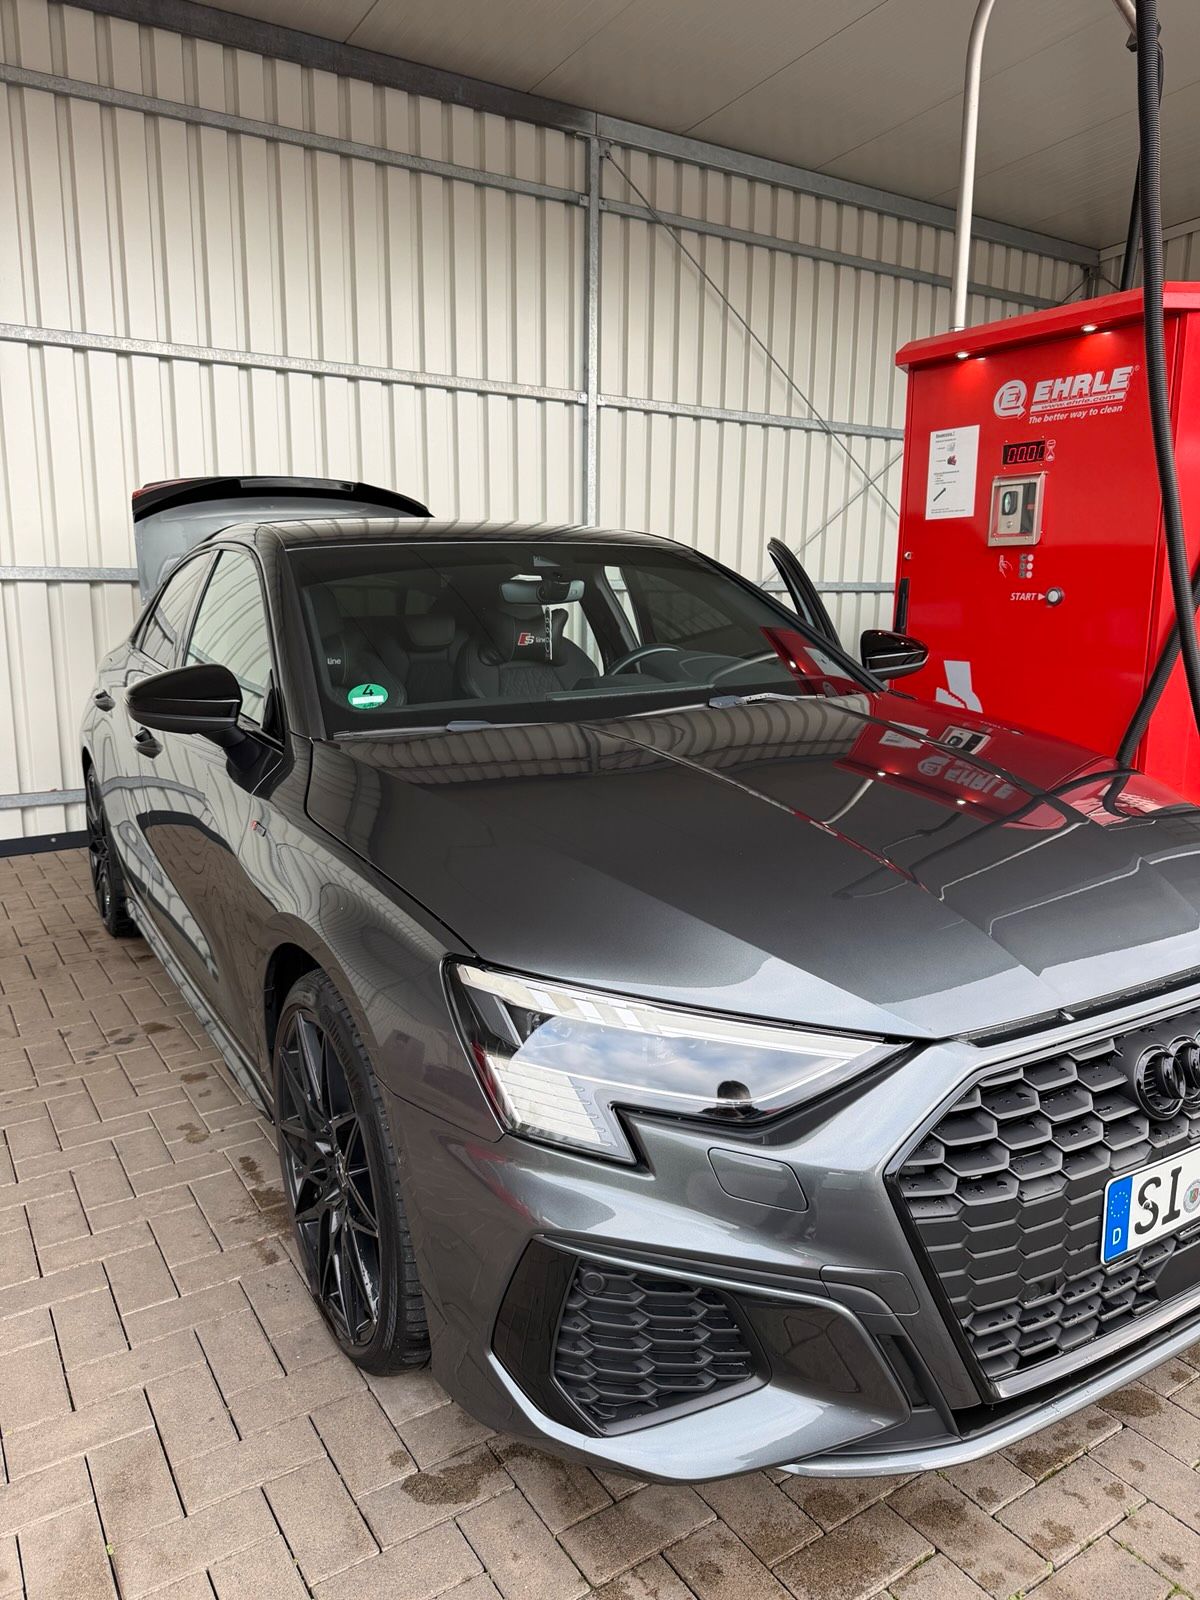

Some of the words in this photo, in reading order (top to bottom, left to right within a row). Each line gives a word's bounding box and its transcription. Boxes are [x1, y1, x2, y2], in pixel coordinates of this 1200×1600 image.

[1033, 366, 1134, 403] EHRLE
[1041, 394, 1116, 409] www.ehrle.com
[1028, 416, 1041, 424] The
[1043, 413, 1067, 423] better
[1070, 410, 1087, 420] way
[1089, 407, 1098, 416] to
[1100, 404, 1123, 414] clean
[1010, 592, 1037, 601] START
[362, 684, 374, 696] 4
[1134, 1166, 1182, 1235] SI
[1112, 1227, 1122, 1246] D
